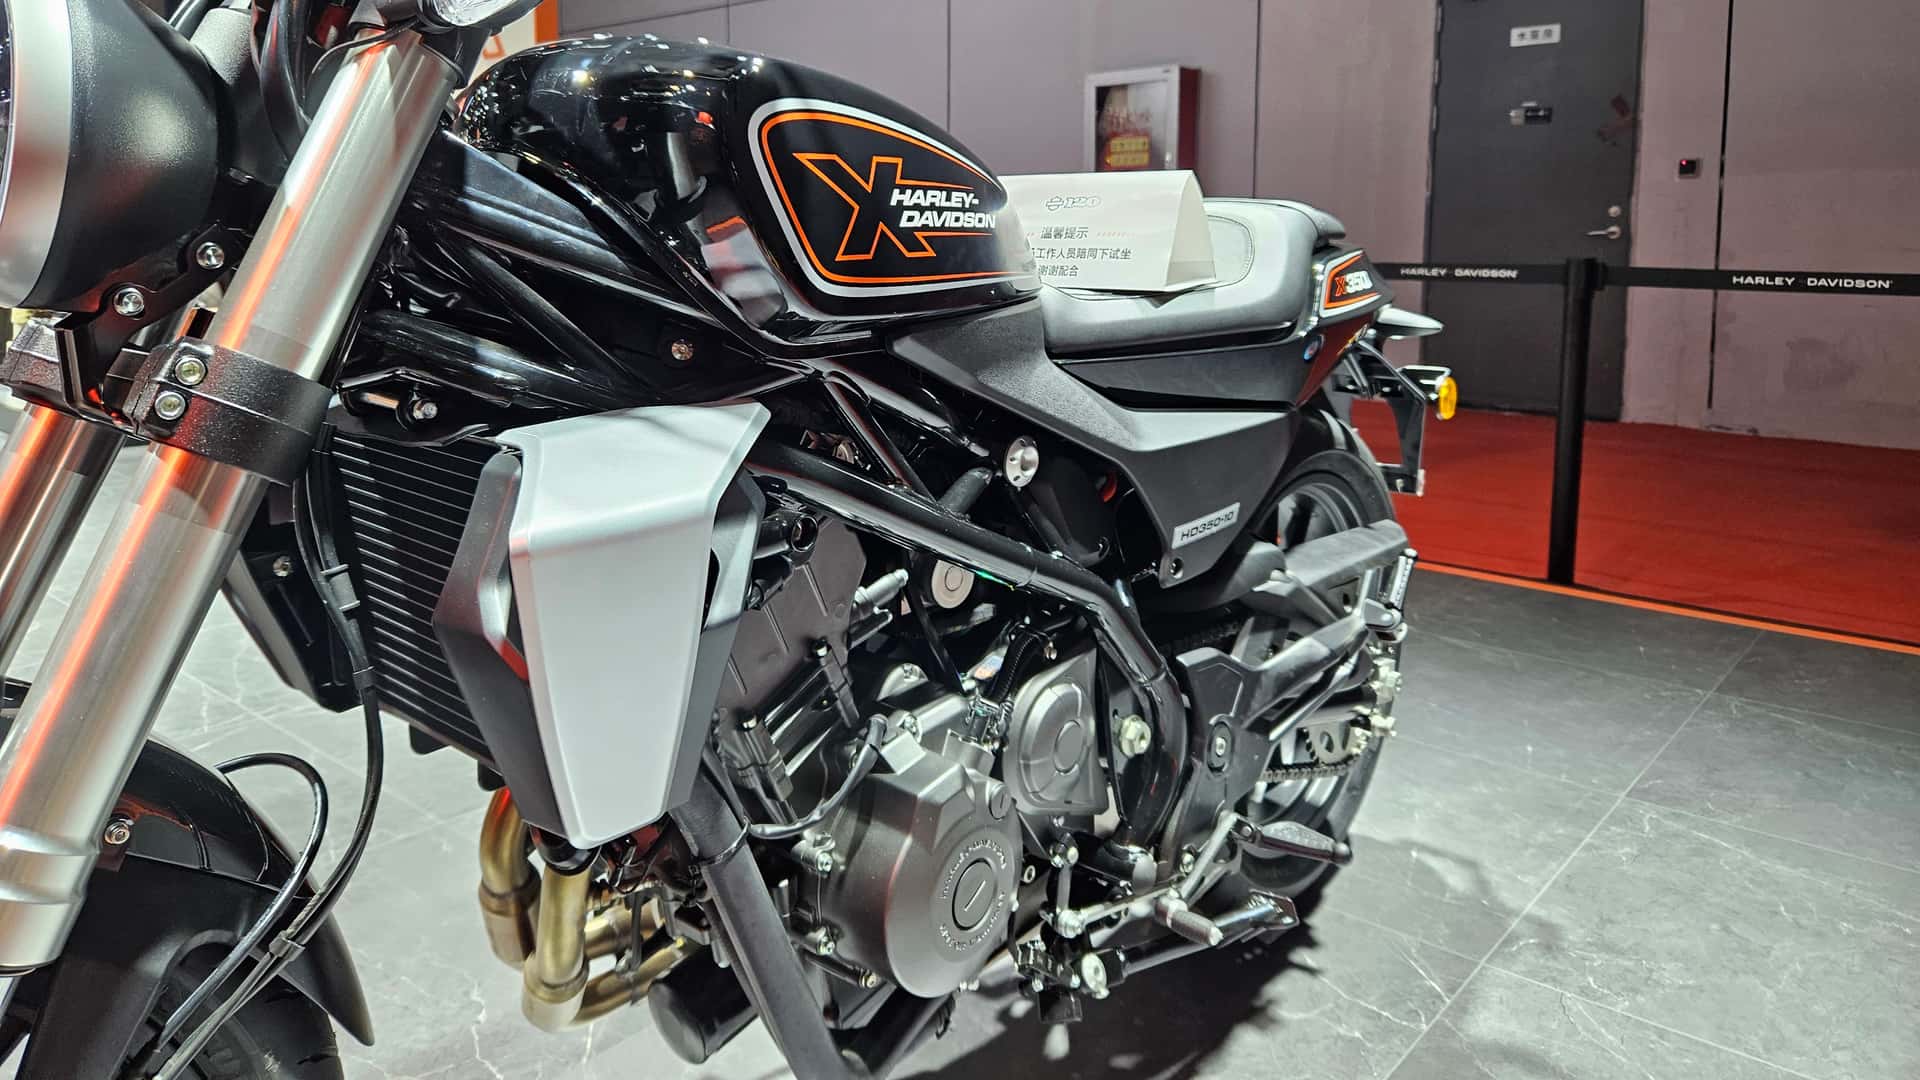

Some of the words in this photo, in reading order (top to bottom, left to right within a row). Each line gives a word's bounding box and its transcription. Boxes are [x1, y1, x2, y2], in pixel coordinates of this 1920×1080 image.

[889, 188, 979, 207] HARLEY-
[899, 210, 996, 229] DAVIDSON
[1040, 226, 1088, 239] 温馨提示
[1031, 247, 1132, 260] 工作人员陪同下试坐
[1400, 267, 1447, 277] HARLEY
[1454, 268, 1518, 279] DAVIDSON
[1732, 275, 1795, 286] HARLEY
[1807, 277, 1891, 289] DAVIDSON
[1181, 511, 1234, 541] HD350-10
